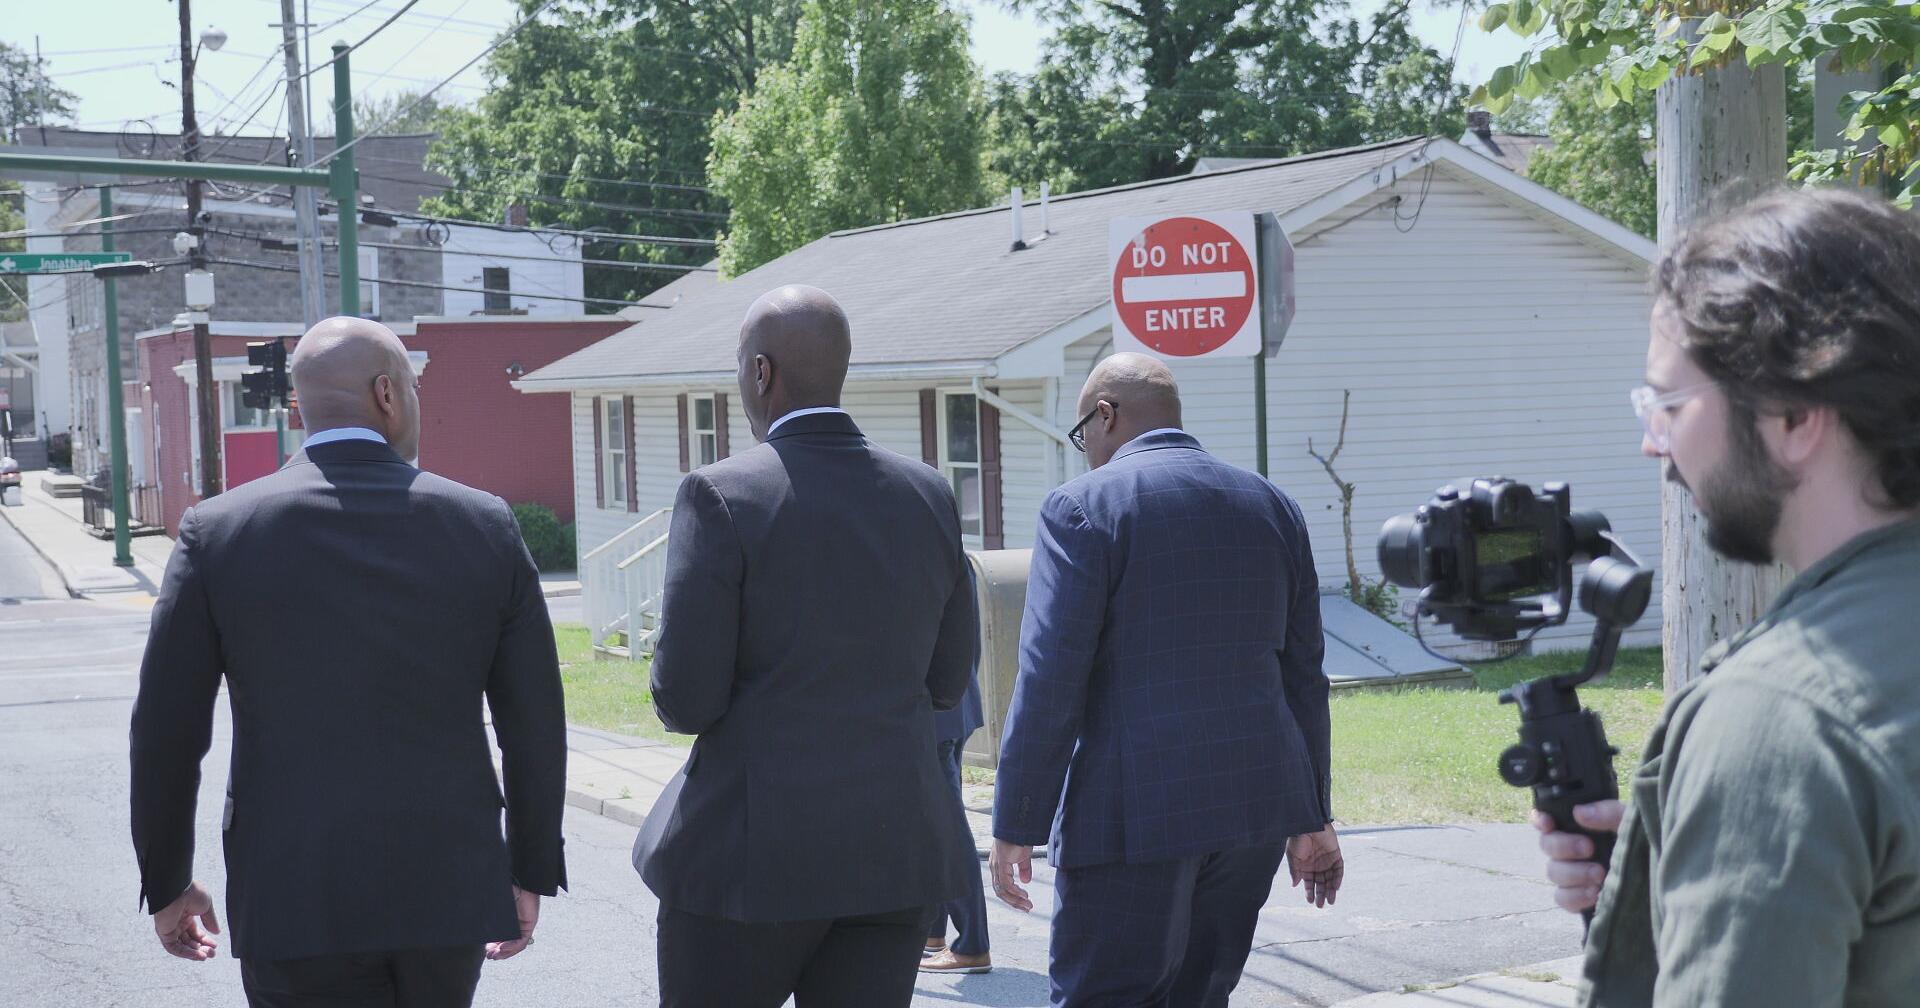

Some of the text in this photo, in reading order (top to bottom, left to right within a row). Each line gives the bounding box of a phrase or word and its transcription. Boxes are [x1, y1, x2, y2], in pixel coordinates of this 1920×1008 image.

[40, 257, 92, 270] Jonathan
[1132, 242, 1231, 268] DO NOT
[1145, 307, 1225, 331] ENTER
